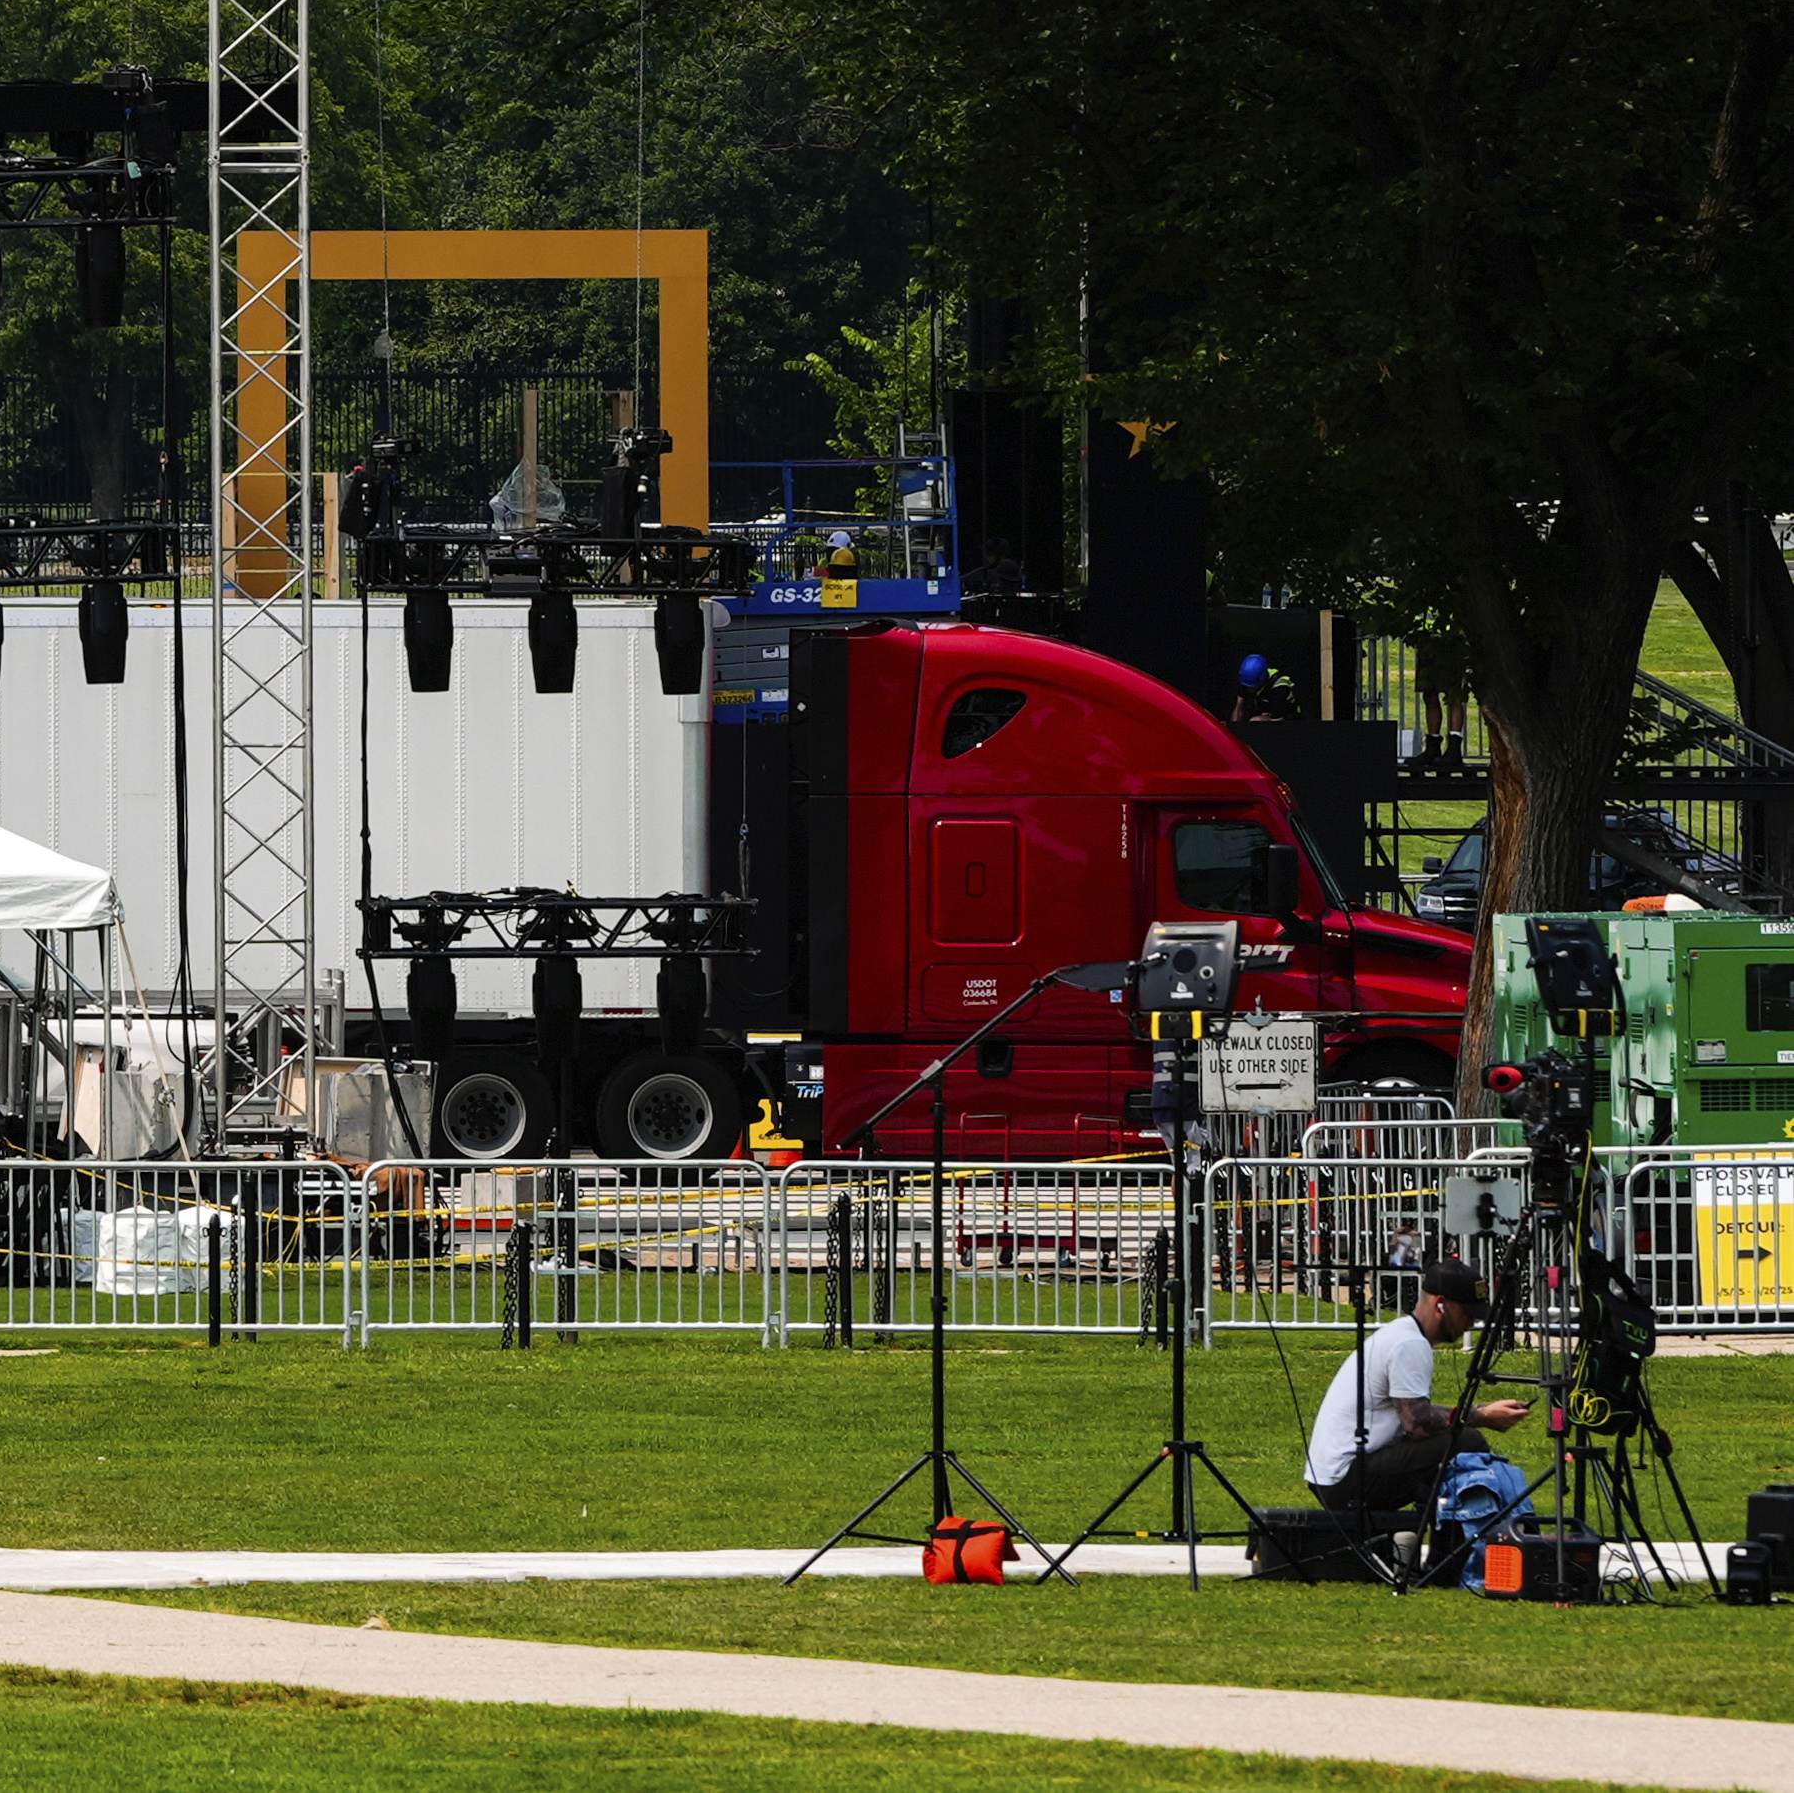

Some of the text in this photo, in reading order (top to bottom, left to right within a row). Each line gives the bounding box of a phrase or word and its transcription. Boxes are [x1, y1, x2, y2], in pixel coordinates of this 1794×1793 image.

[966, 979, 997, 988] USDOT
[1203, 1036, 1314, 1051] SIEWALK CLOSED
[1209, 1059, 1309, 1074] USE OTHER SIDE
[1716, 1184, 1775, 1197] CLOSED
